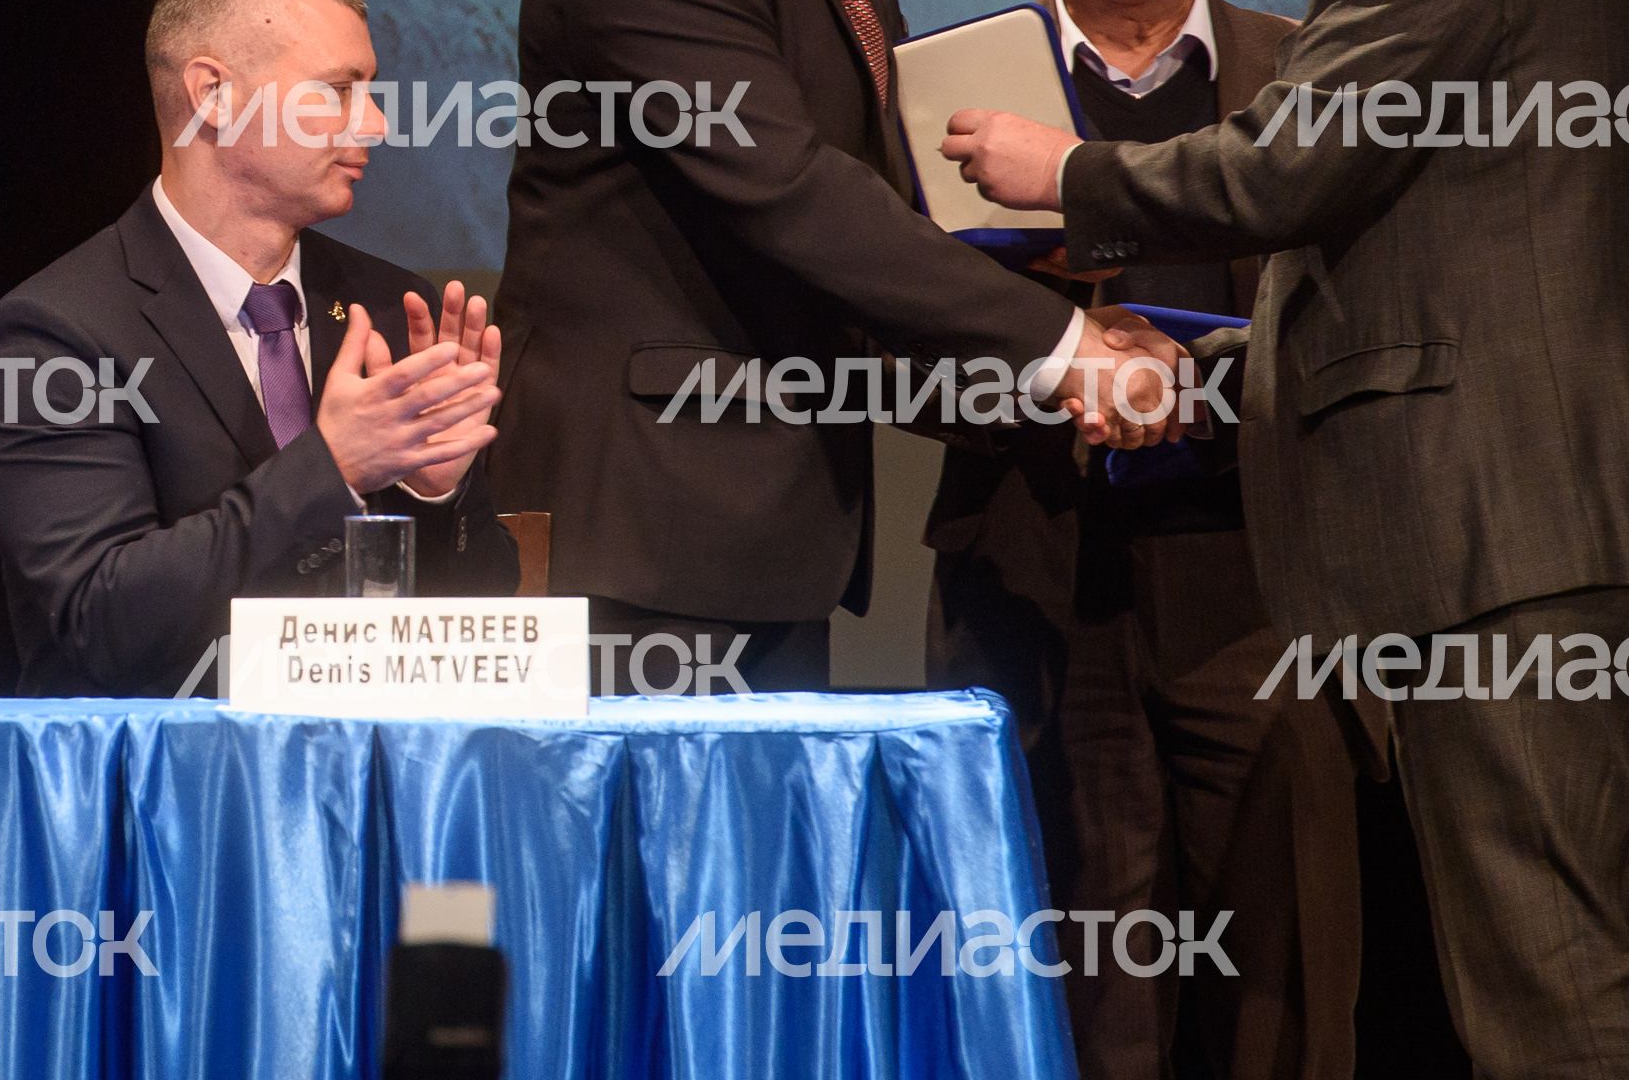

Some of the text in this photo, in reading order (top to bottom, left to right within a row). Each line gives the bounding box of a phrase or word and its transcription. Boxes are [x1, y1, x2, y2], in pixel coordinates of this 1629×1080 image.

[280, 615, 539, 649] Денис МАТВЕЕВ
[287, 655, 533, 683] Denis MATVEEV
